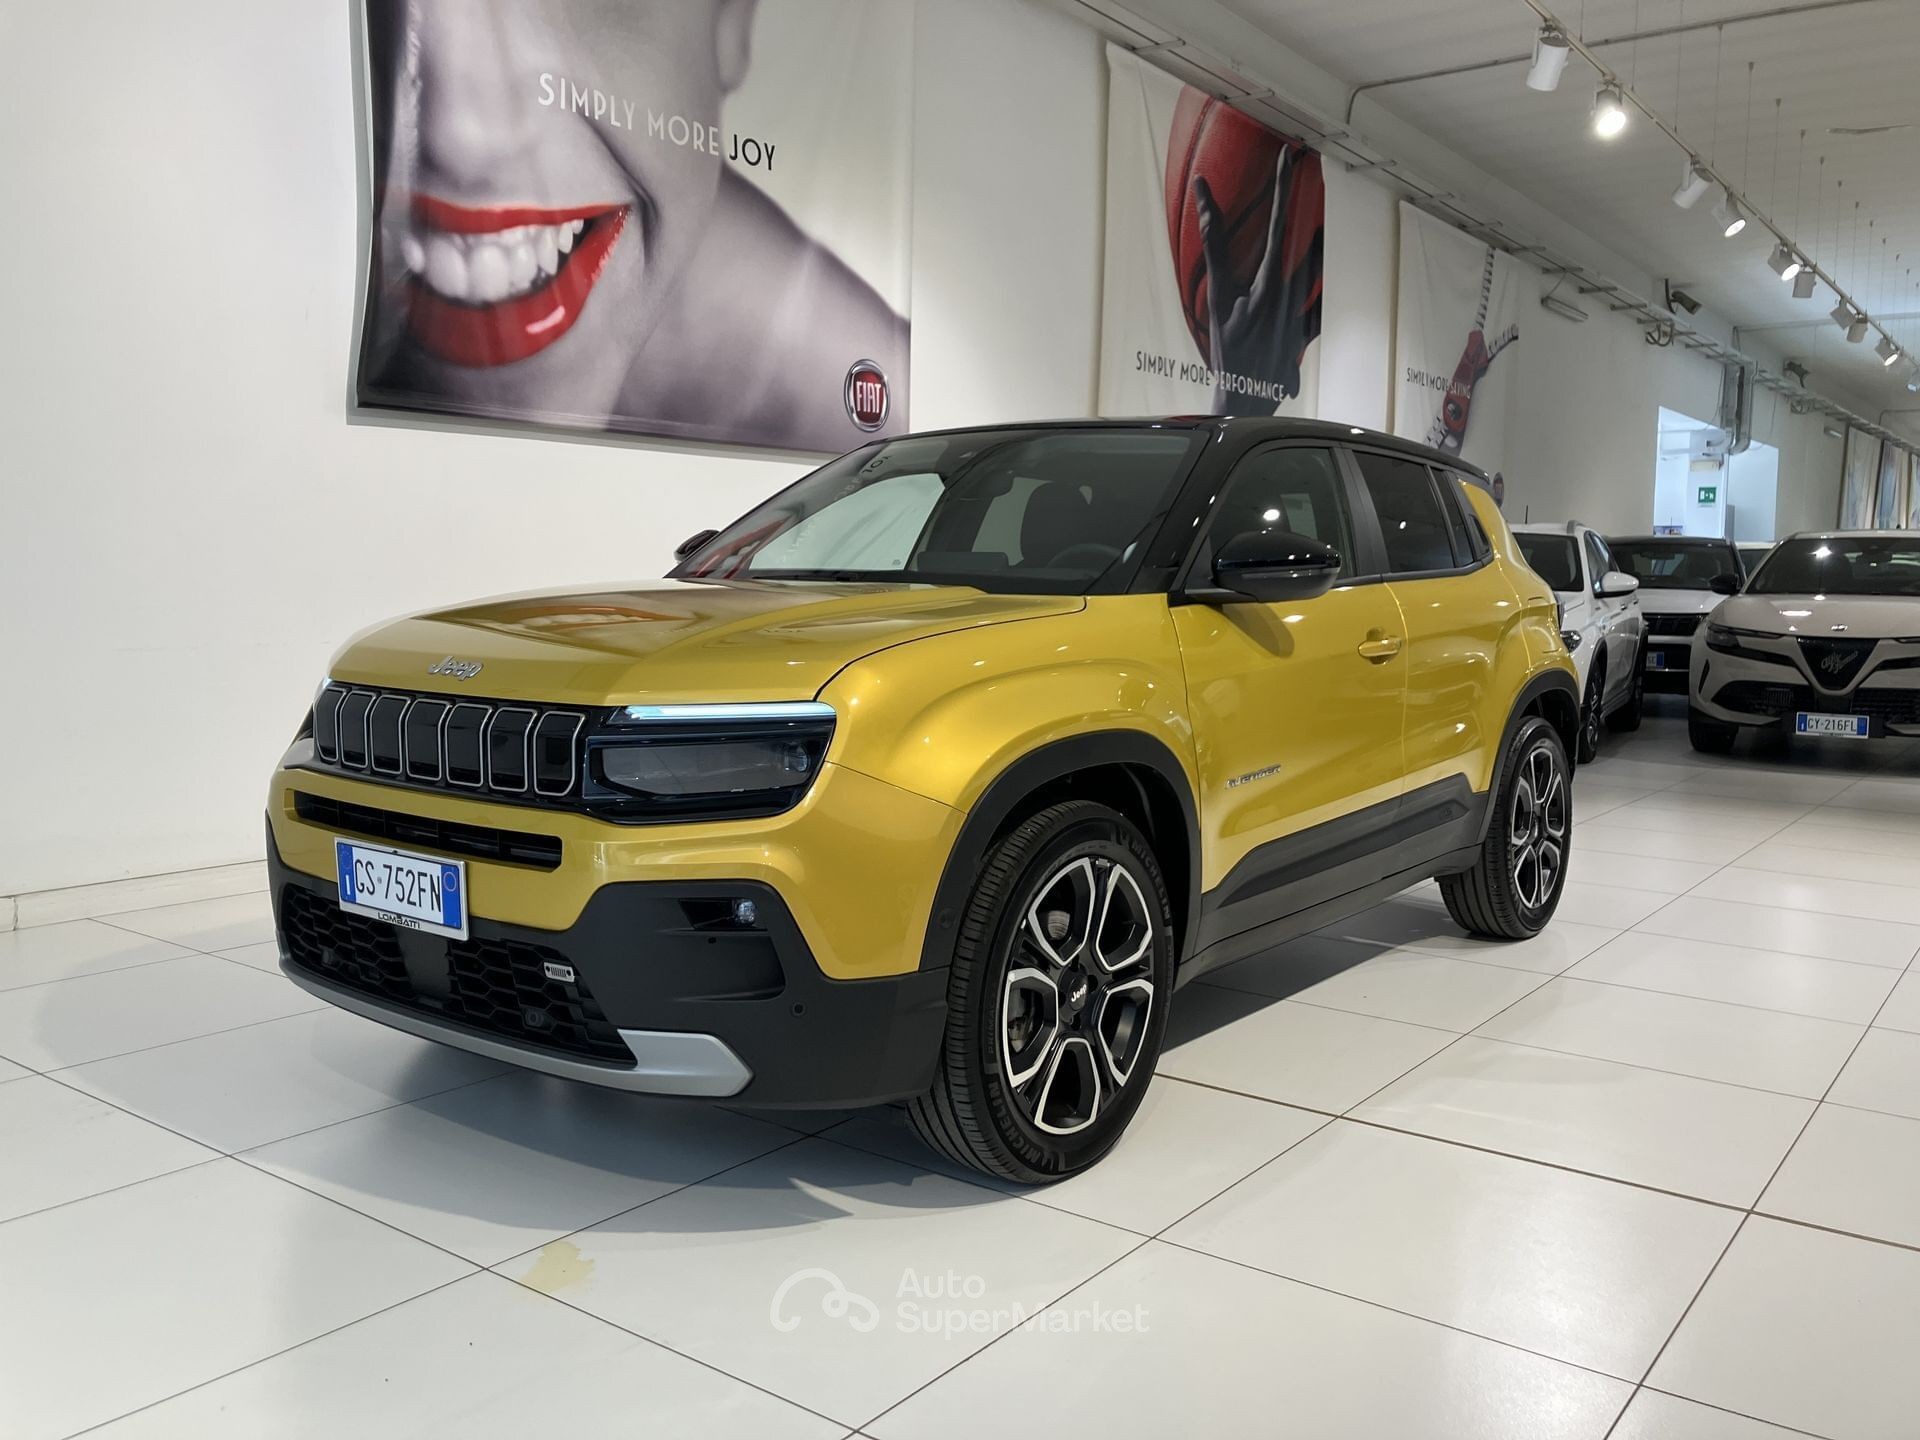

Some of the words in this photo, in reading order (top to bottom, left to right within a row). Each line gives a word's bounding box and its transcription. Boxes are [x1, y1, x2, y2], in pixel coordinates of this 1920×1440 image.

[537, 72, 636, 131] SIMPLY
[647, 107, 719, 157] MORE
[728, 133, 776, 171] JOY
[855, 379, 883, 414] FIAT
[1135, 351, 1175, 378] SIMPLY
[1180, 362, 1211, 387] MORE
[1214, 369, 1285, 402] PERFORMANCE
[427, 655, 484, 682] Jeep
